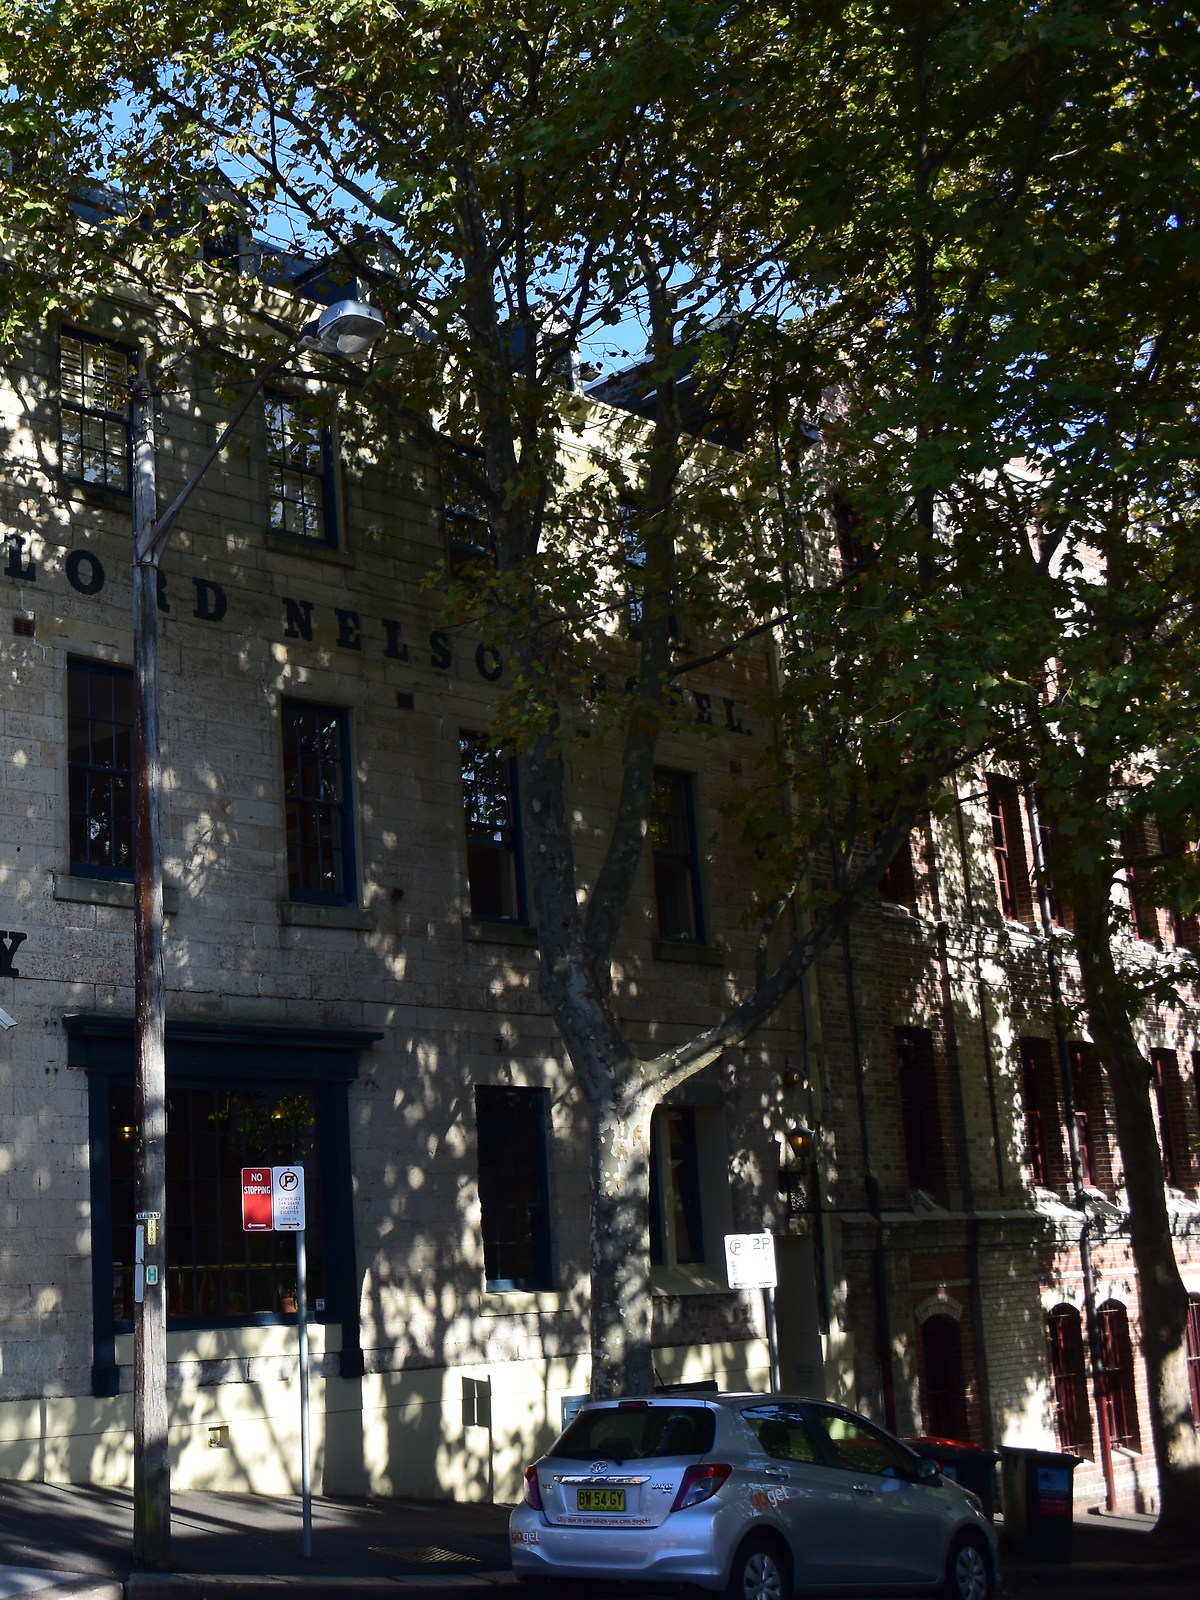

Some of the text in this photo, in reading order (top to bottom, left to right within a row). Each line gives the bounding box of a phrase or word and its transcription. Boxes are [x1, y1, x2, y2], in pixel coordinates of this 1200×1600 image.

[282, 597, 505, 682] NELSO
[251, 1173, 263, 1182] NO
[244, 1185, 271, 1195] STOPPING
[752, 1237, 770, 1250] 2P
[147, 1268, 157, 1281] H
[512, 1530, 540, 1544] goget
